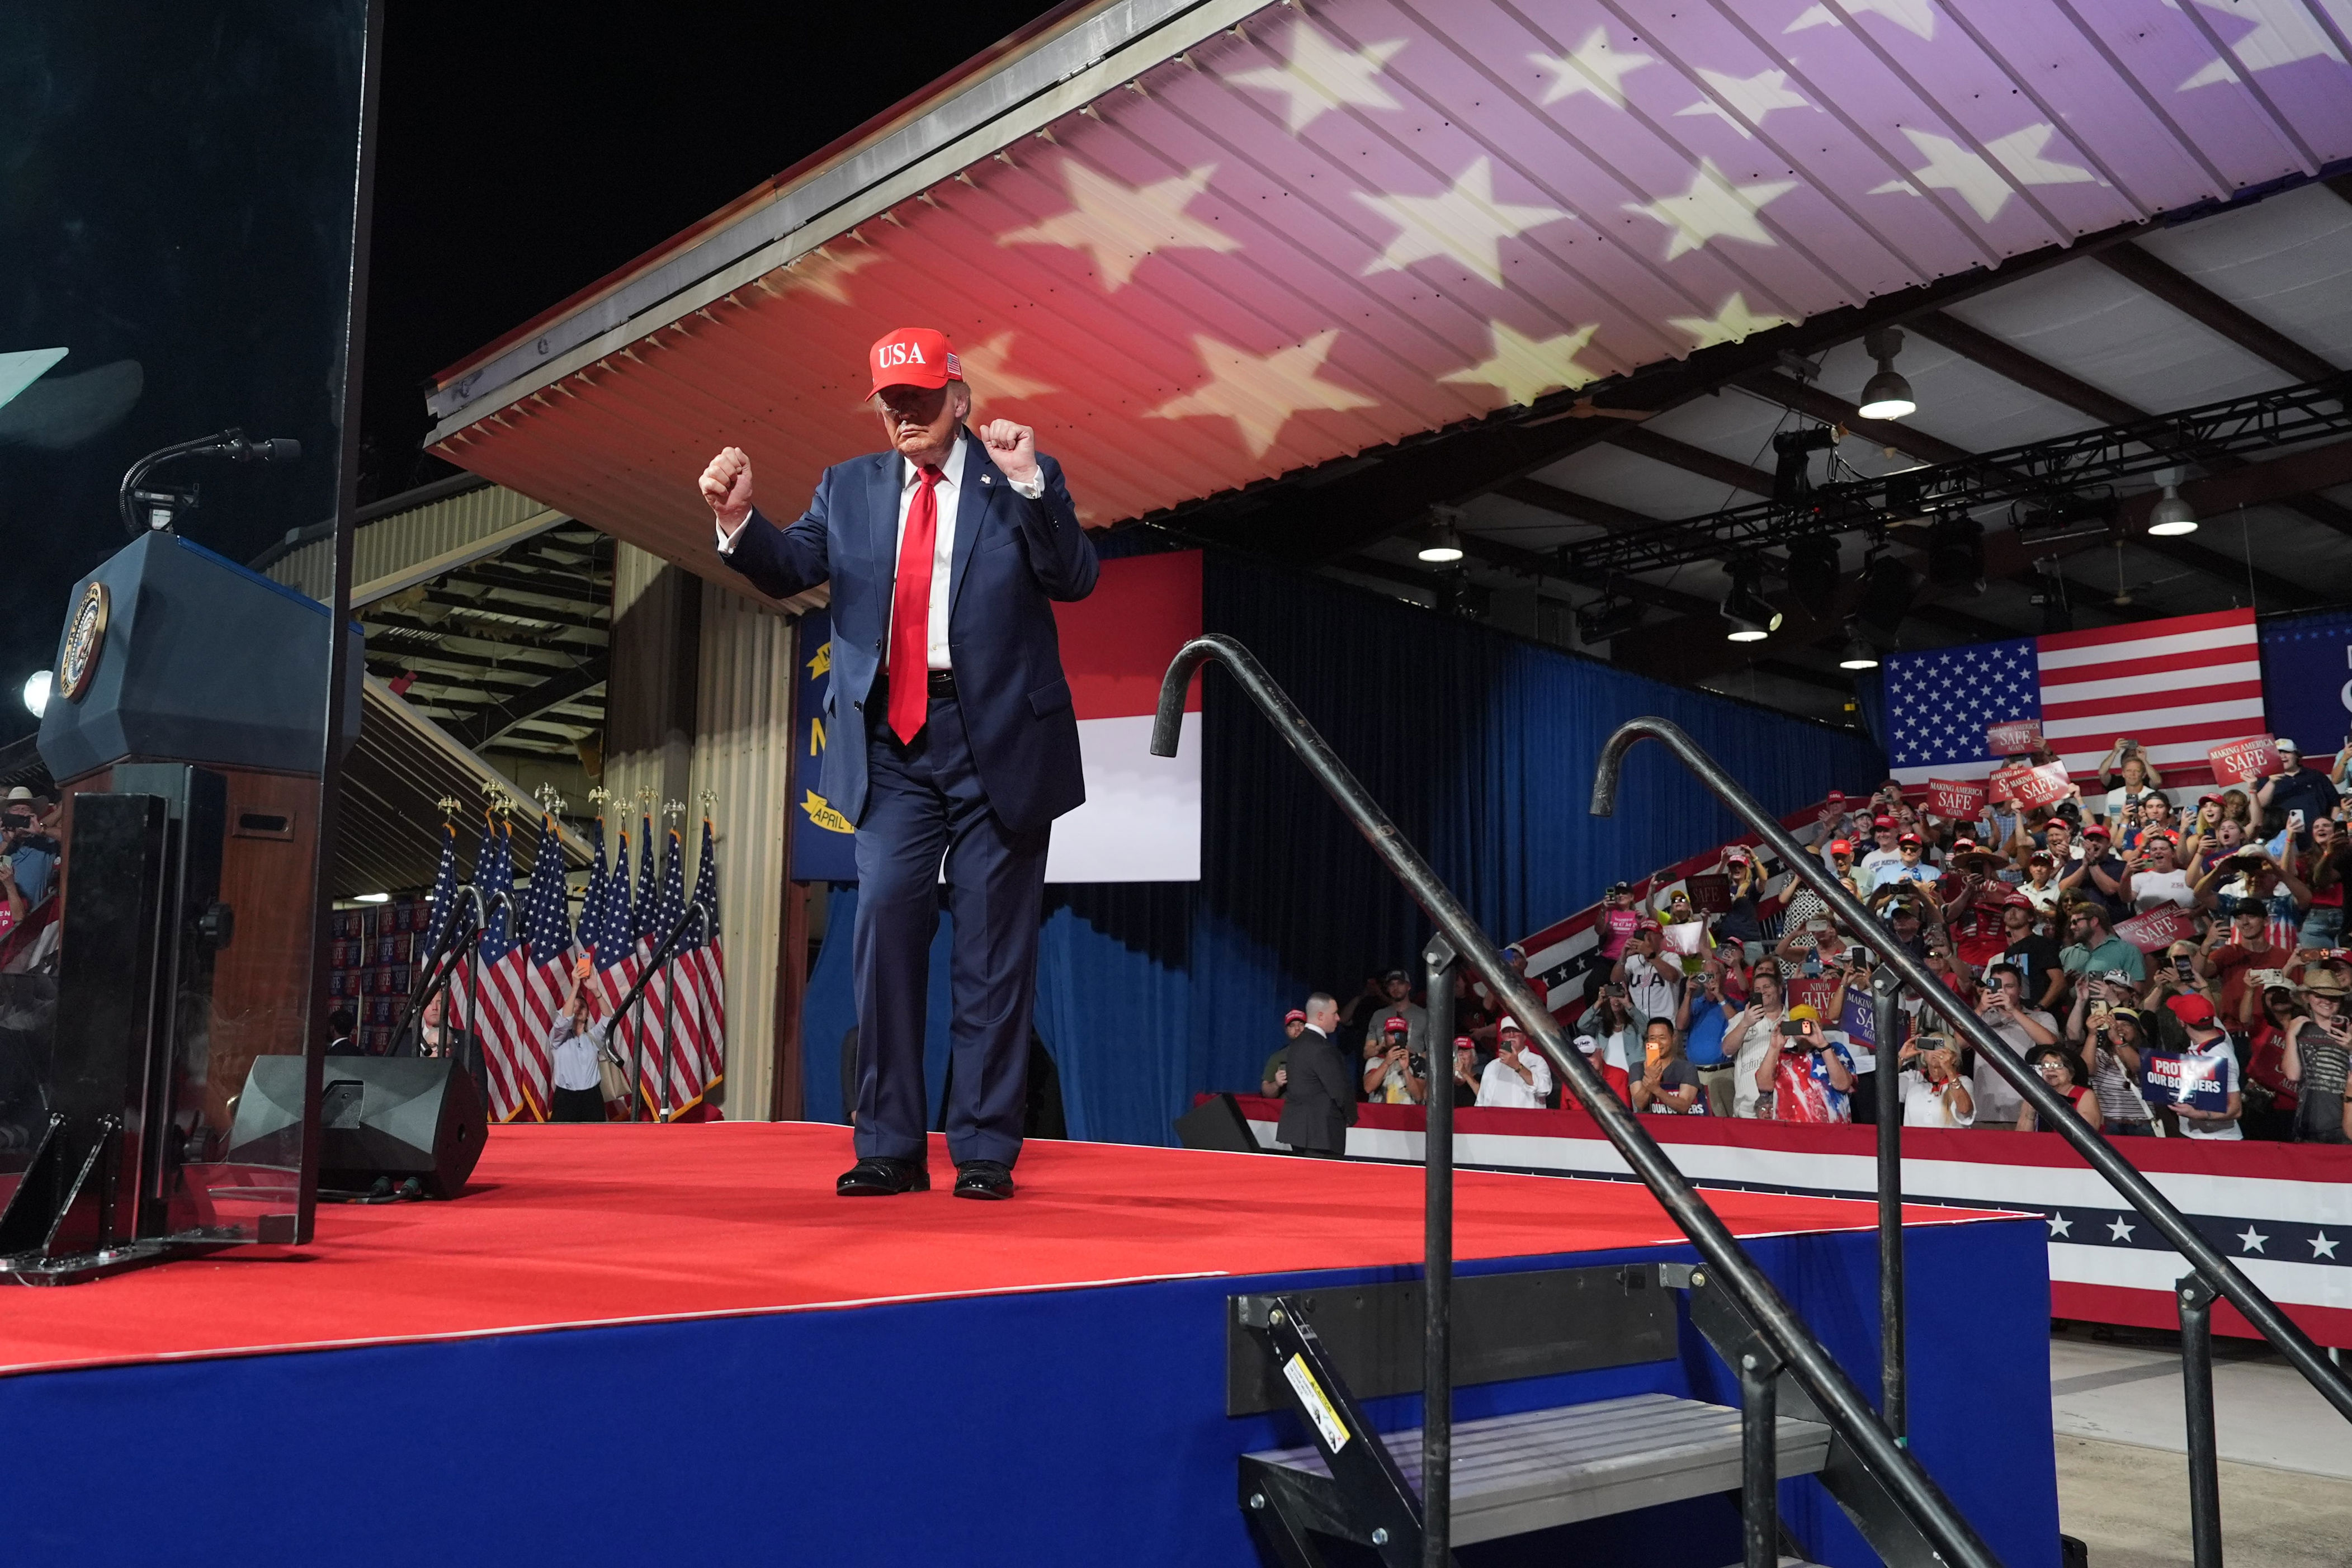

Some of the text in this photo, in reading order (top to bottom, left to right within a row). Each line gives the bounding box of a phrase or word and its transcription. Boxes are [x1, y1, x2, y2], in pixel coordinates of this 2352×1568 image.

[879, 342, 926, 369] USA
[1999, 730, 2031, 746] SAFE
[2211, 739, 2274, 759] MAKING AMERICA
[2225, 749, 2268, 773] SAFE
[1991, 771, 2012, 781] MAKING
[2010, 774, 2033, 788] MAKING
[1930, 782, 1983, 796] MAKING AMERICA
[2022, 778, 2058, 799] SAFE
[1938, 792, 1972, 811] SAFE
[2035, 792, 2054, 804] AGAIN
[814, 808, 845, 829] APRIL
[1945, 808, 1964, 817] AGAIN
[2118, 904, 2180, 933] MAKING AMERICA
[2136, 916, 2178, 943] SAFE
[2153, 935, 2175, 947] AGAIN
[1810, 983, 1831, 991] AGAIN
[1856, 1008, 1874, 1031] SA
[1862, 1029, 1876, 1041] AGA
[2156, 1059, 2211, 1077] PROTET
[2147, 1072, 2221, 1093] OUR BORDERS
[1651, 1103, 1704, 1114] OUR BERS
[1314, 1385, 1332, 1413] CAUTION
